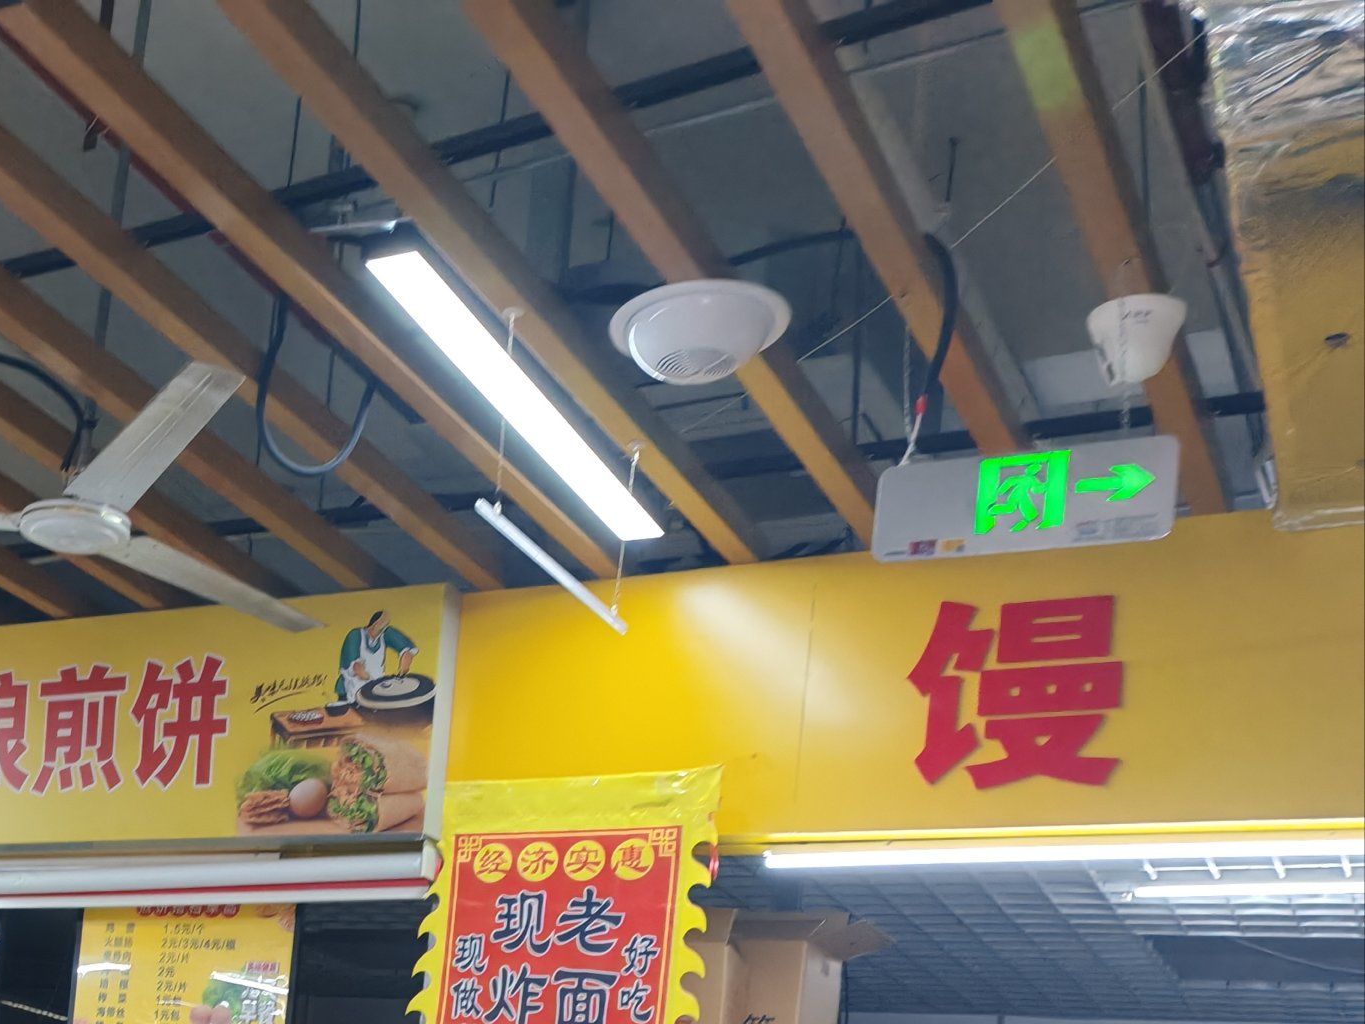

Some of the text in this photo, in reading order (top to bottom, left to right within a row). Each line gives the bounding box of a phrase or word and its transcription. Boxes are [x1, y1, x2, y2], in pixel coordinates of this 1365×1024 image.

[907, 595, 1123, 790] 馒
[475, 840, 653, 883] 经济实惠
